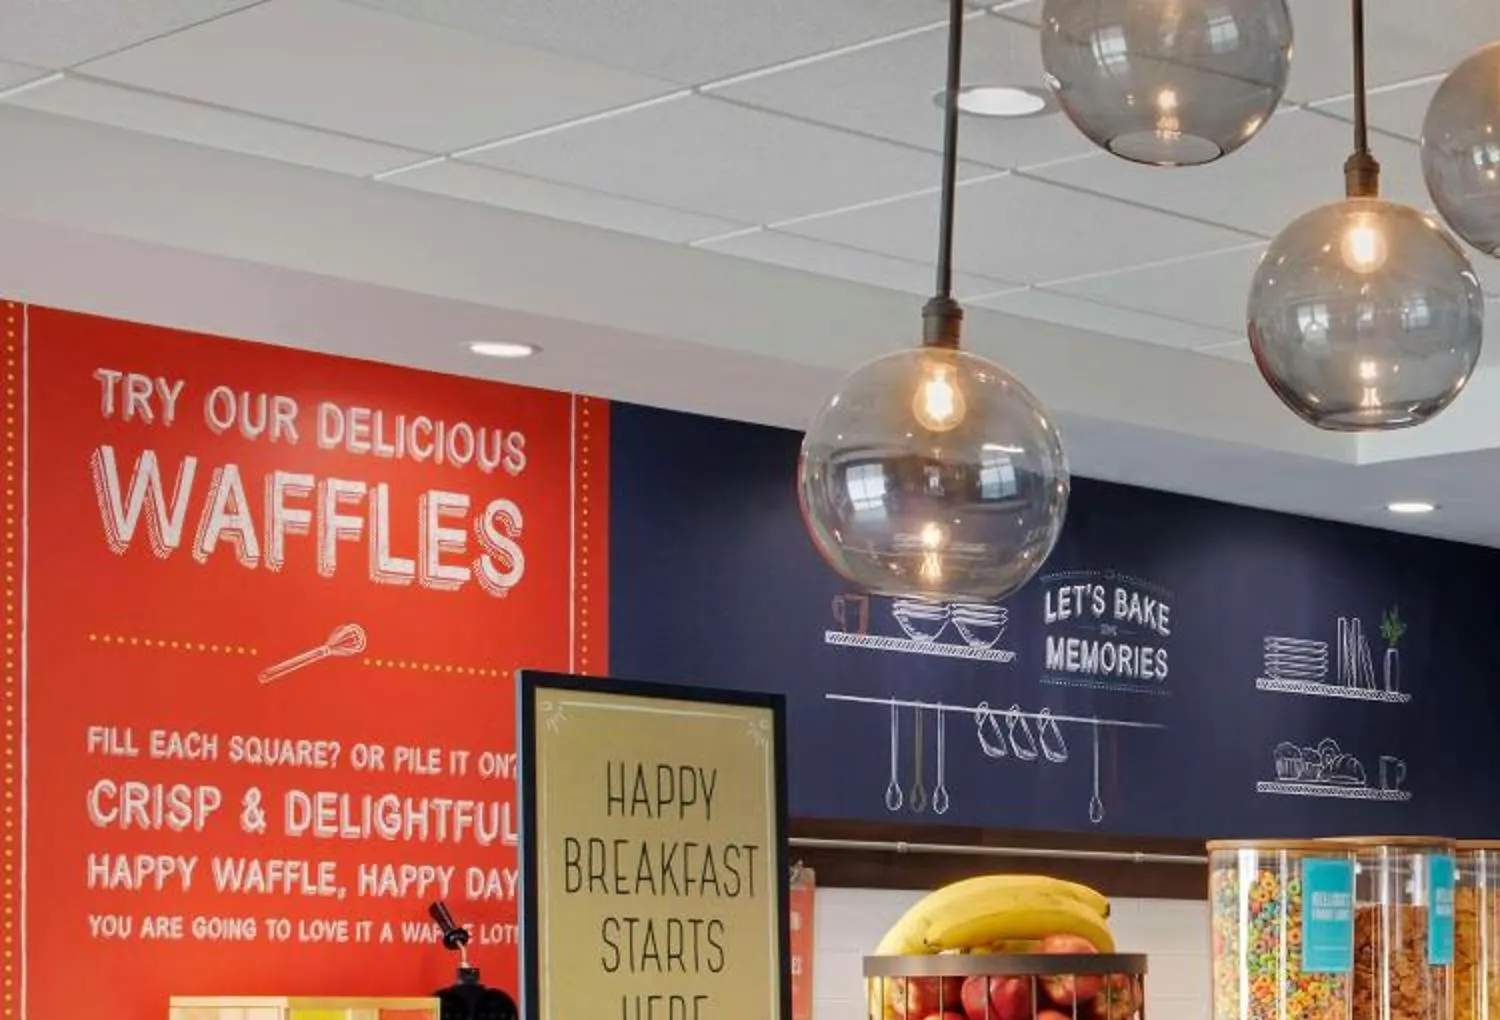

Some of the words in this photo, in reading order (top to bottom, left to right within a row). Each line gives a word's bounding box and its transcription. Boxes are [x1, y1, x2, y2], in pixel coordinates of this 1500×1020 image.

[93, 367, 185, 425] TRY
[205, 386, 299, 444] OUR
[316, 402, 528, 476] DELICIOUS
[91, 444, 526, 599] WAFFLES
[1044, 583, 1106, 624] LET'S
[1113, 587, 1171, 637] BAKE
[1045, 636, 1169, 681] MEMORIES
[87, 727, 138, 757] FILL
[150, 730, 218, 760] EACH
[228, 735, 341, 769] SQUARE?
[350, 743, 385, 771] OR
[393, 746, 442, 775] PILE
[450, 750, 470, 777] IT
[87, 779, 222, 832] CRISP
[239, 787, 267, 834] &
[284, 789, 519, 846] DELIGHTFUL
[606, 760, 719, 821] HAPPY
[87, 854, 199, 892] HAPPY
[211, 857, 347, 900] WAFFLE,
[358, 863, 456, 899] HAPPY
[464, 867, 519, 901] DAY
[564, 837, 760, 898] BREAKFAST
[88, 915, 132, 940] YOU
[140, 916, 183, 941] ARE
[191, 917, 257, 941] GOING
[264, 918, 291, 942] TO
[298, 918, 349, 943] LOVE
[355, 919, 375, 943] IT
[379, 921, 394, 943] A
[401, 921, 474, 945] WAFE
[601, 917, 726, 974] STARTS
